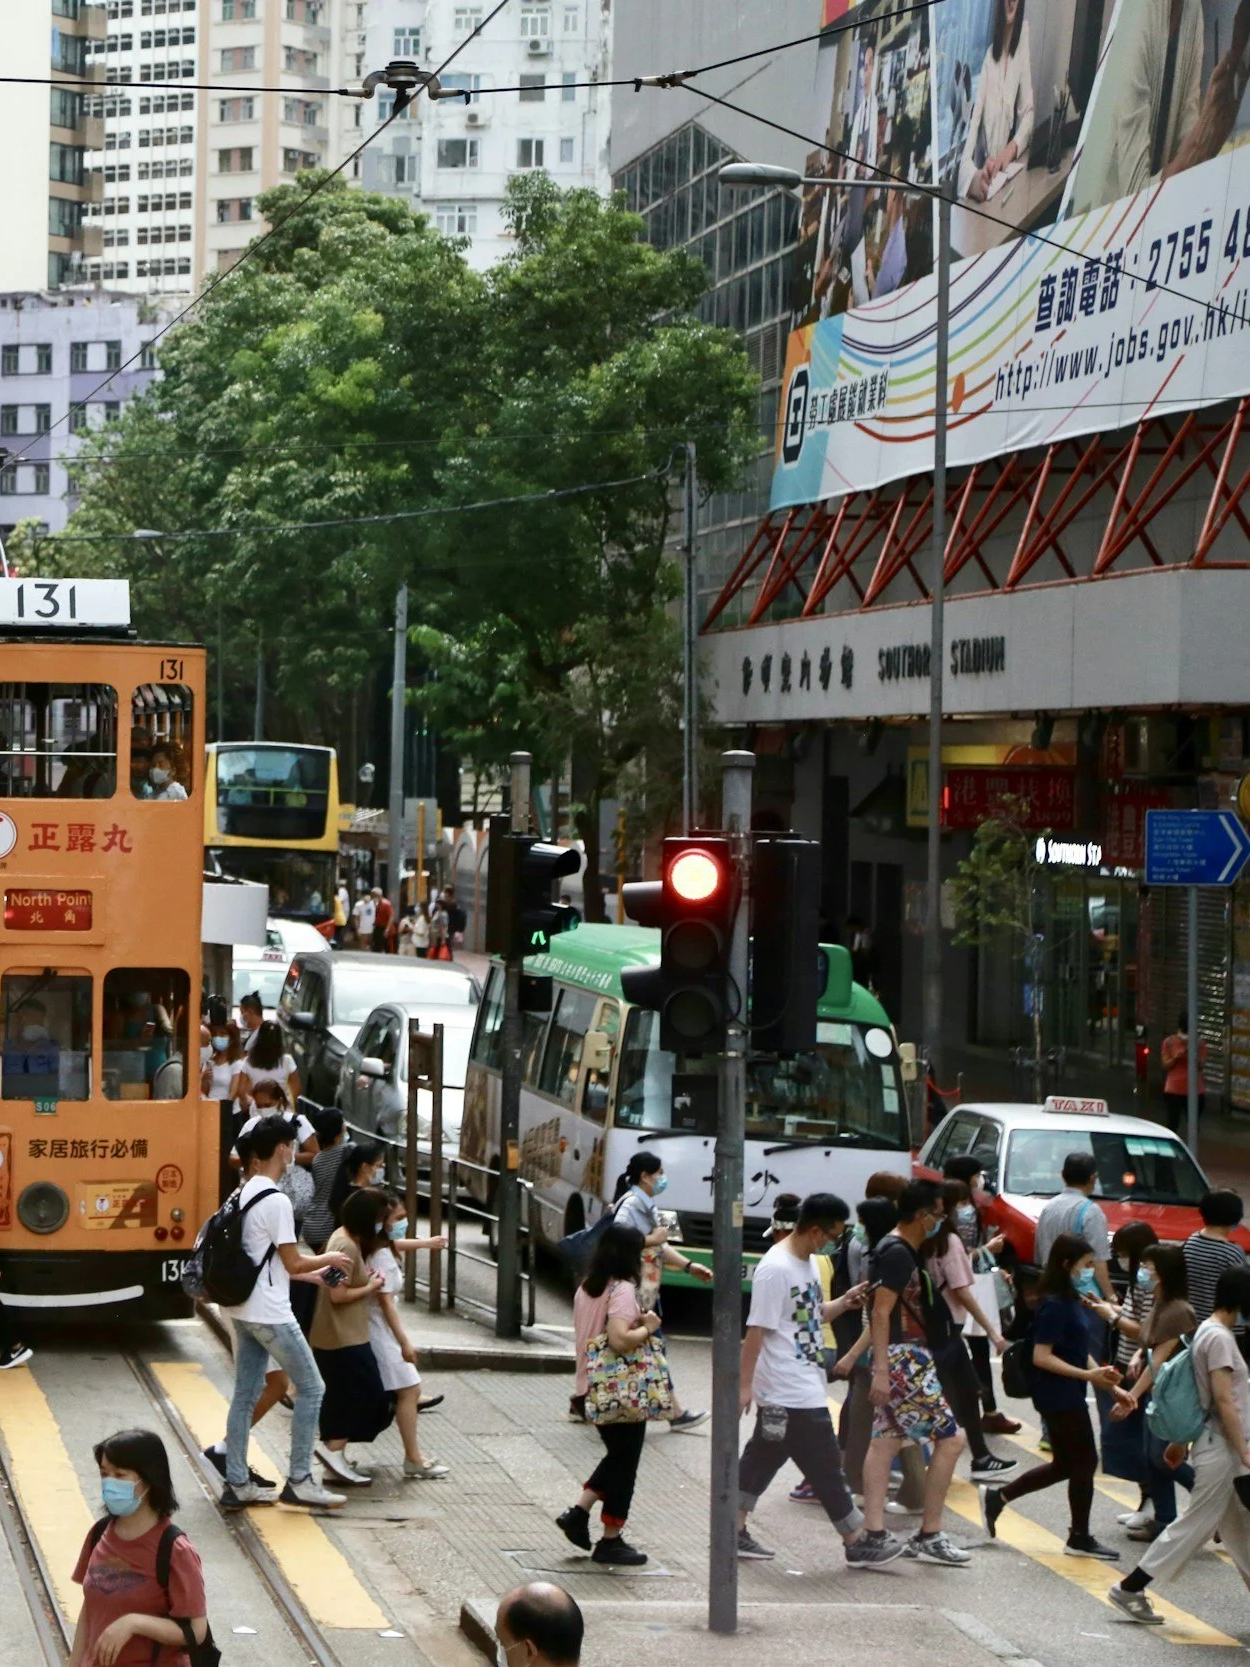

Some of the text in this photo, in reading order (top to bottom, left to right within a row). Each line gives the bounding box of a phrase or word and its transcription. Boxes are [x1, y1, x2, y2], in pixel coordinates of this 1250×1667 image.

[1145, 218, 1214, 293] 2755
[16, 583, 77, 619] 131
[878, 642, 932, 680] SOUTHOR
[950, 635, 1006, 678] STADIUM
[159, 658, 184, 681] 131
[27, 822, 134, 854] 正露丸
[11, 891, 92, 907] North Point
[29, 909, 76, 925] 北角
[35, 1101, 57, 1112] S06
[1050, 1098, 1105, 1113] TAXI
[28, 1138, 149, 1160] 家居旅行必備
[161, 1169, 178, 1179] 日本
